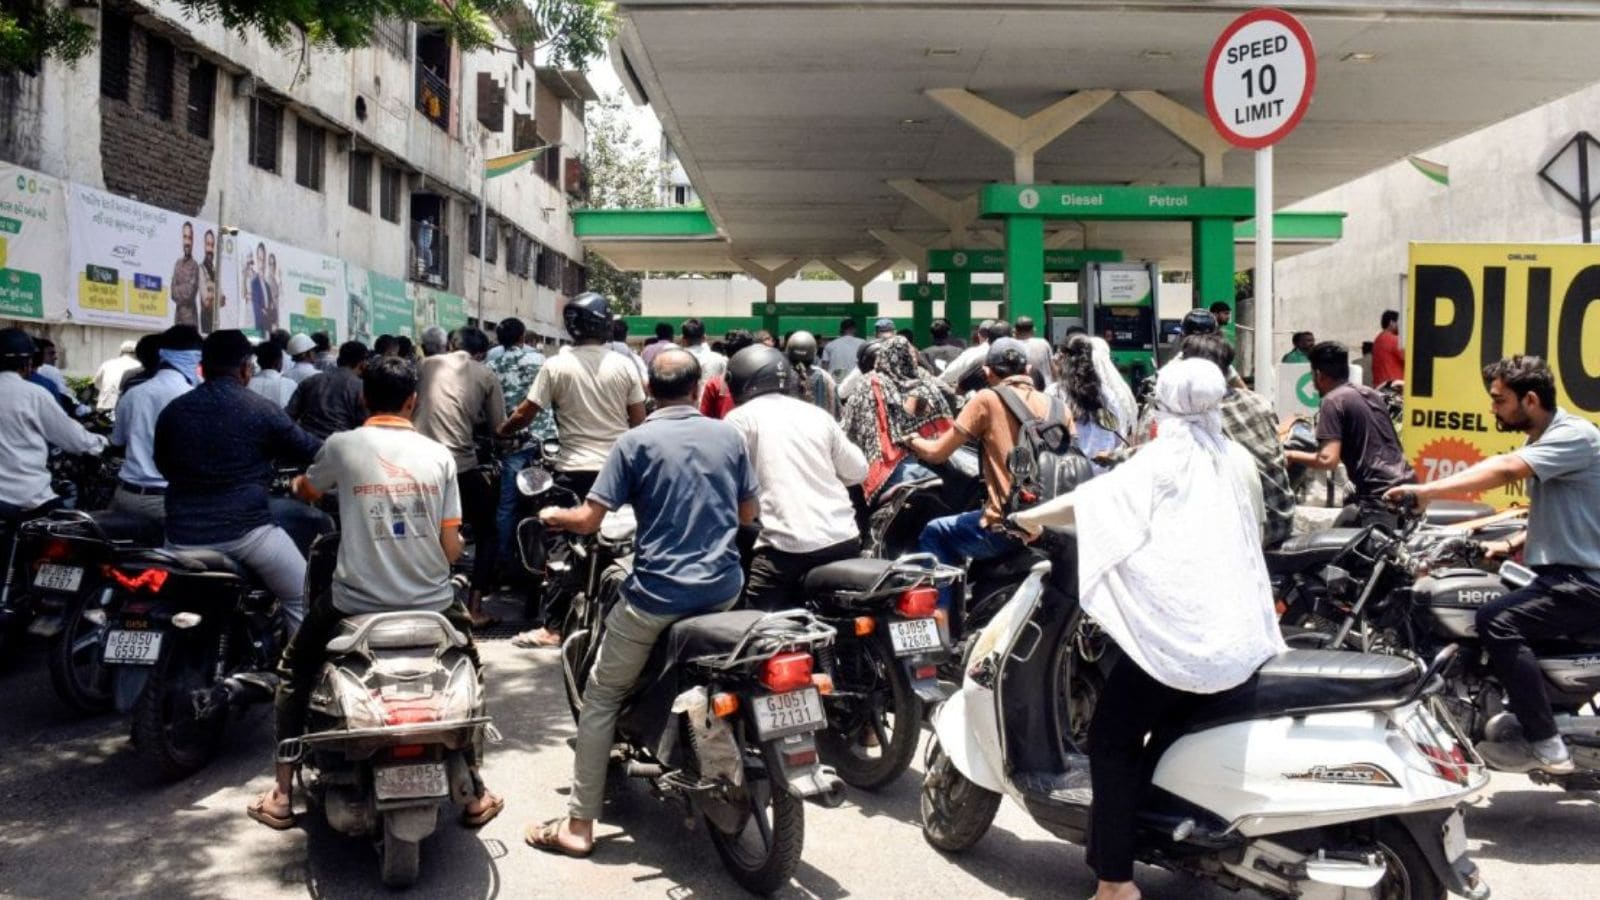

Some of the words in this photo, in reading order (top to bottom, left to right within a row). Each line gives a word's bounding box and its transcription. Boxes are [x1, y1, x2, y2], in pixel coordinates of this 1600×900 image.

[1227, 35, 1288, 64] SPEED
[1241, 64, 1277, 98] 10
[1235, 99, 1284, 125] LIMIT
[1061, 194, 1103, 206] Diesel
[1149, 195, 1188, 206] Petrol
[1411, 264, 1600, 412] PUC
[1412, 409, 1488, 432] DIESEL
[118, 631, 153, 645] GJ05U
[115, 645, 150, 658] G5937
[767, 690, 808, 711] GJ05T
